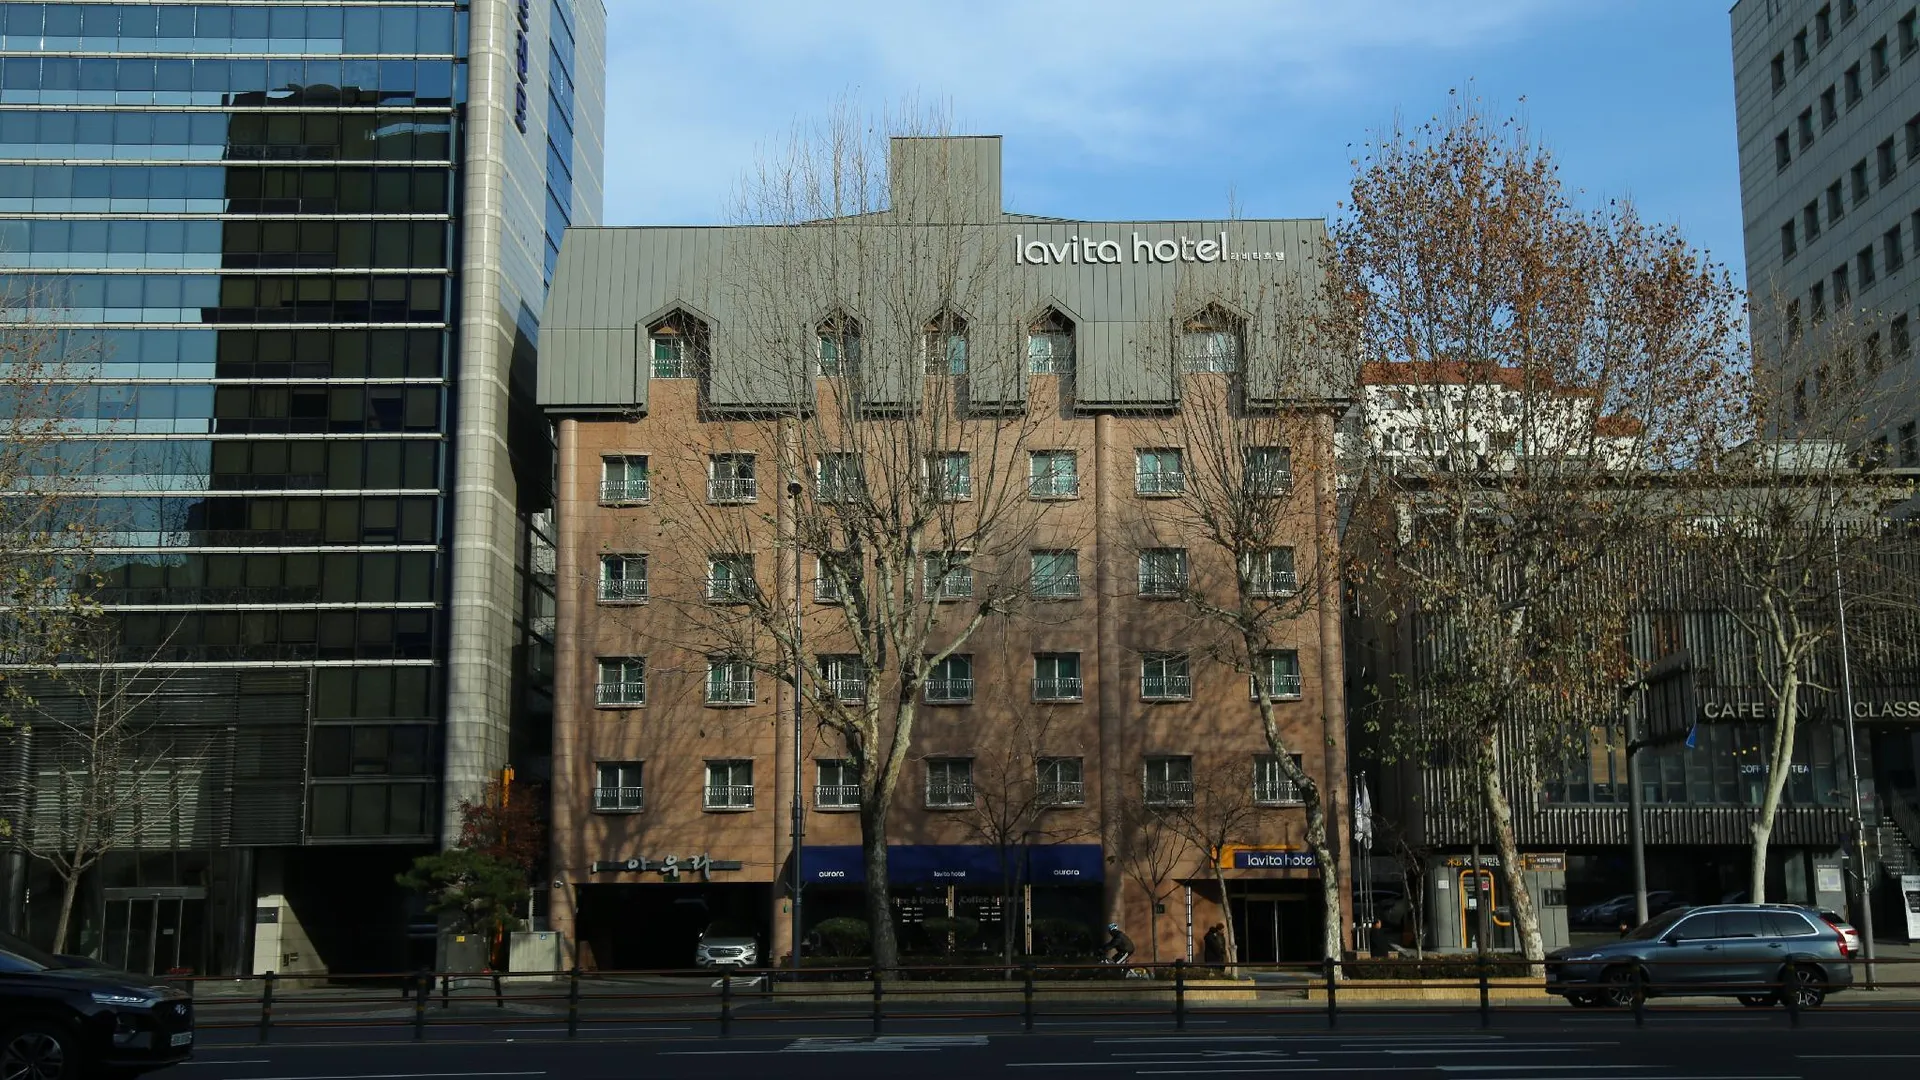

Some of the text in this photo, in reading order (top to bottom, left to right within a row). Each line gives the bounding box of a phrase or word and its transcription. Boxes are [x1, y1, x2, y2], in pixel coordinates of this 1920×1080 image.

[1015, 231, 1227, 264] lavita hotel
[1230, 252, 1284, 262] 라비타호텔
[1704, 702, 1765, 719] CAFE
[1853, 701, 1920, 718] CLASS
[1791, 764, 1809, 774] TEA
[627, 852, 714, 880] 아우라
[1247, 853, 1316, 866] lavita hotel
[818, 870, 845, 878] aurora
[951, 870, 966, 878] hotel
